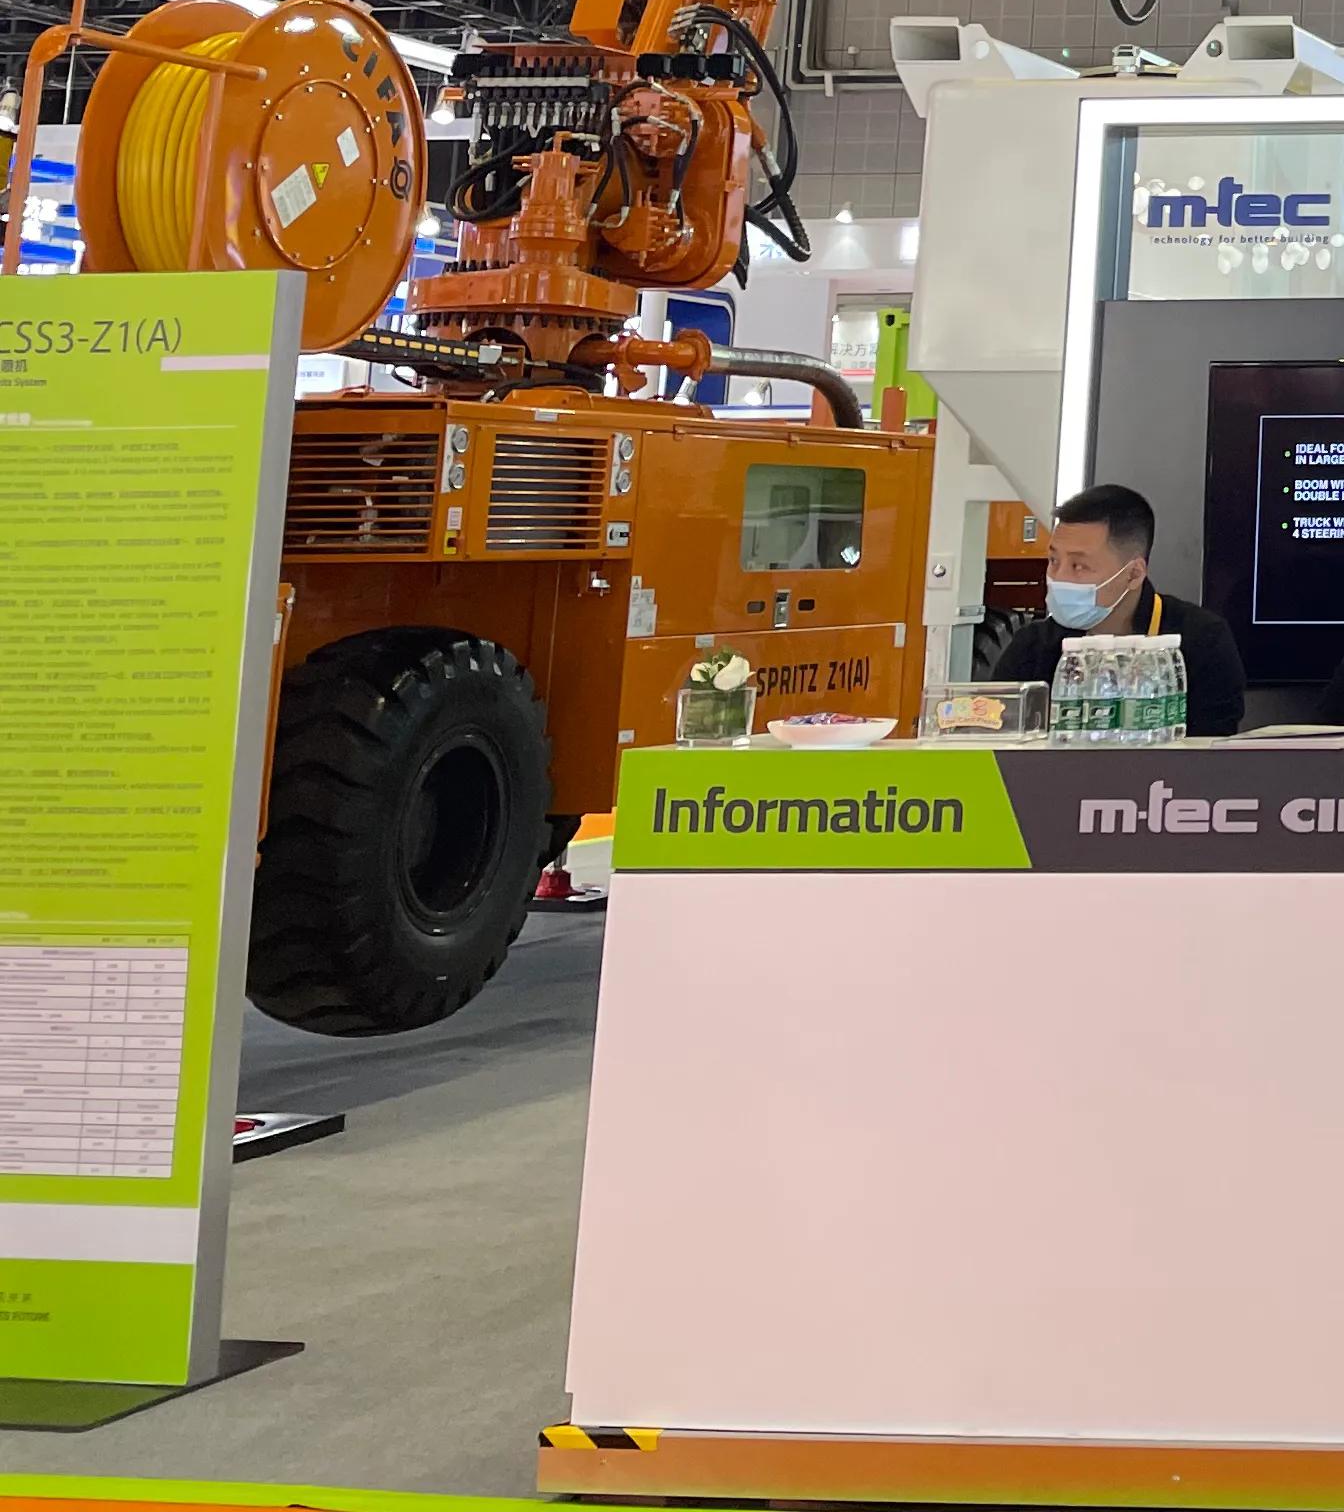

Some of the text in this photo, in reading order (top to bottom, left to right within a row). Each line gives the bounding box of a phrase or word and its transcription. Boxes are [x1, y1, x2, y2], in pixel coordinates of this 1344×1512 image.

[1147, 177, 1331, 228] m-tec
[1218, 234, 1236, 244] for
[1240, 234, 1275, 244] better
[1296, 443, 1328, 454] IDEAL
[1295, 454, 1307, 465] IN
[1294, 479, 1325, 490] BOOM
[1294, 490, 1340, 501] DOUBLE
[1293, 517, 1330, 528] TRUCK
[1292, 529, 1300, 539] 4
[756, 656, 869, 698] SPRITZ Z1(A)
[652, 786, 964, 834] Information
[1079, 780, 1259, 834] m-tec
